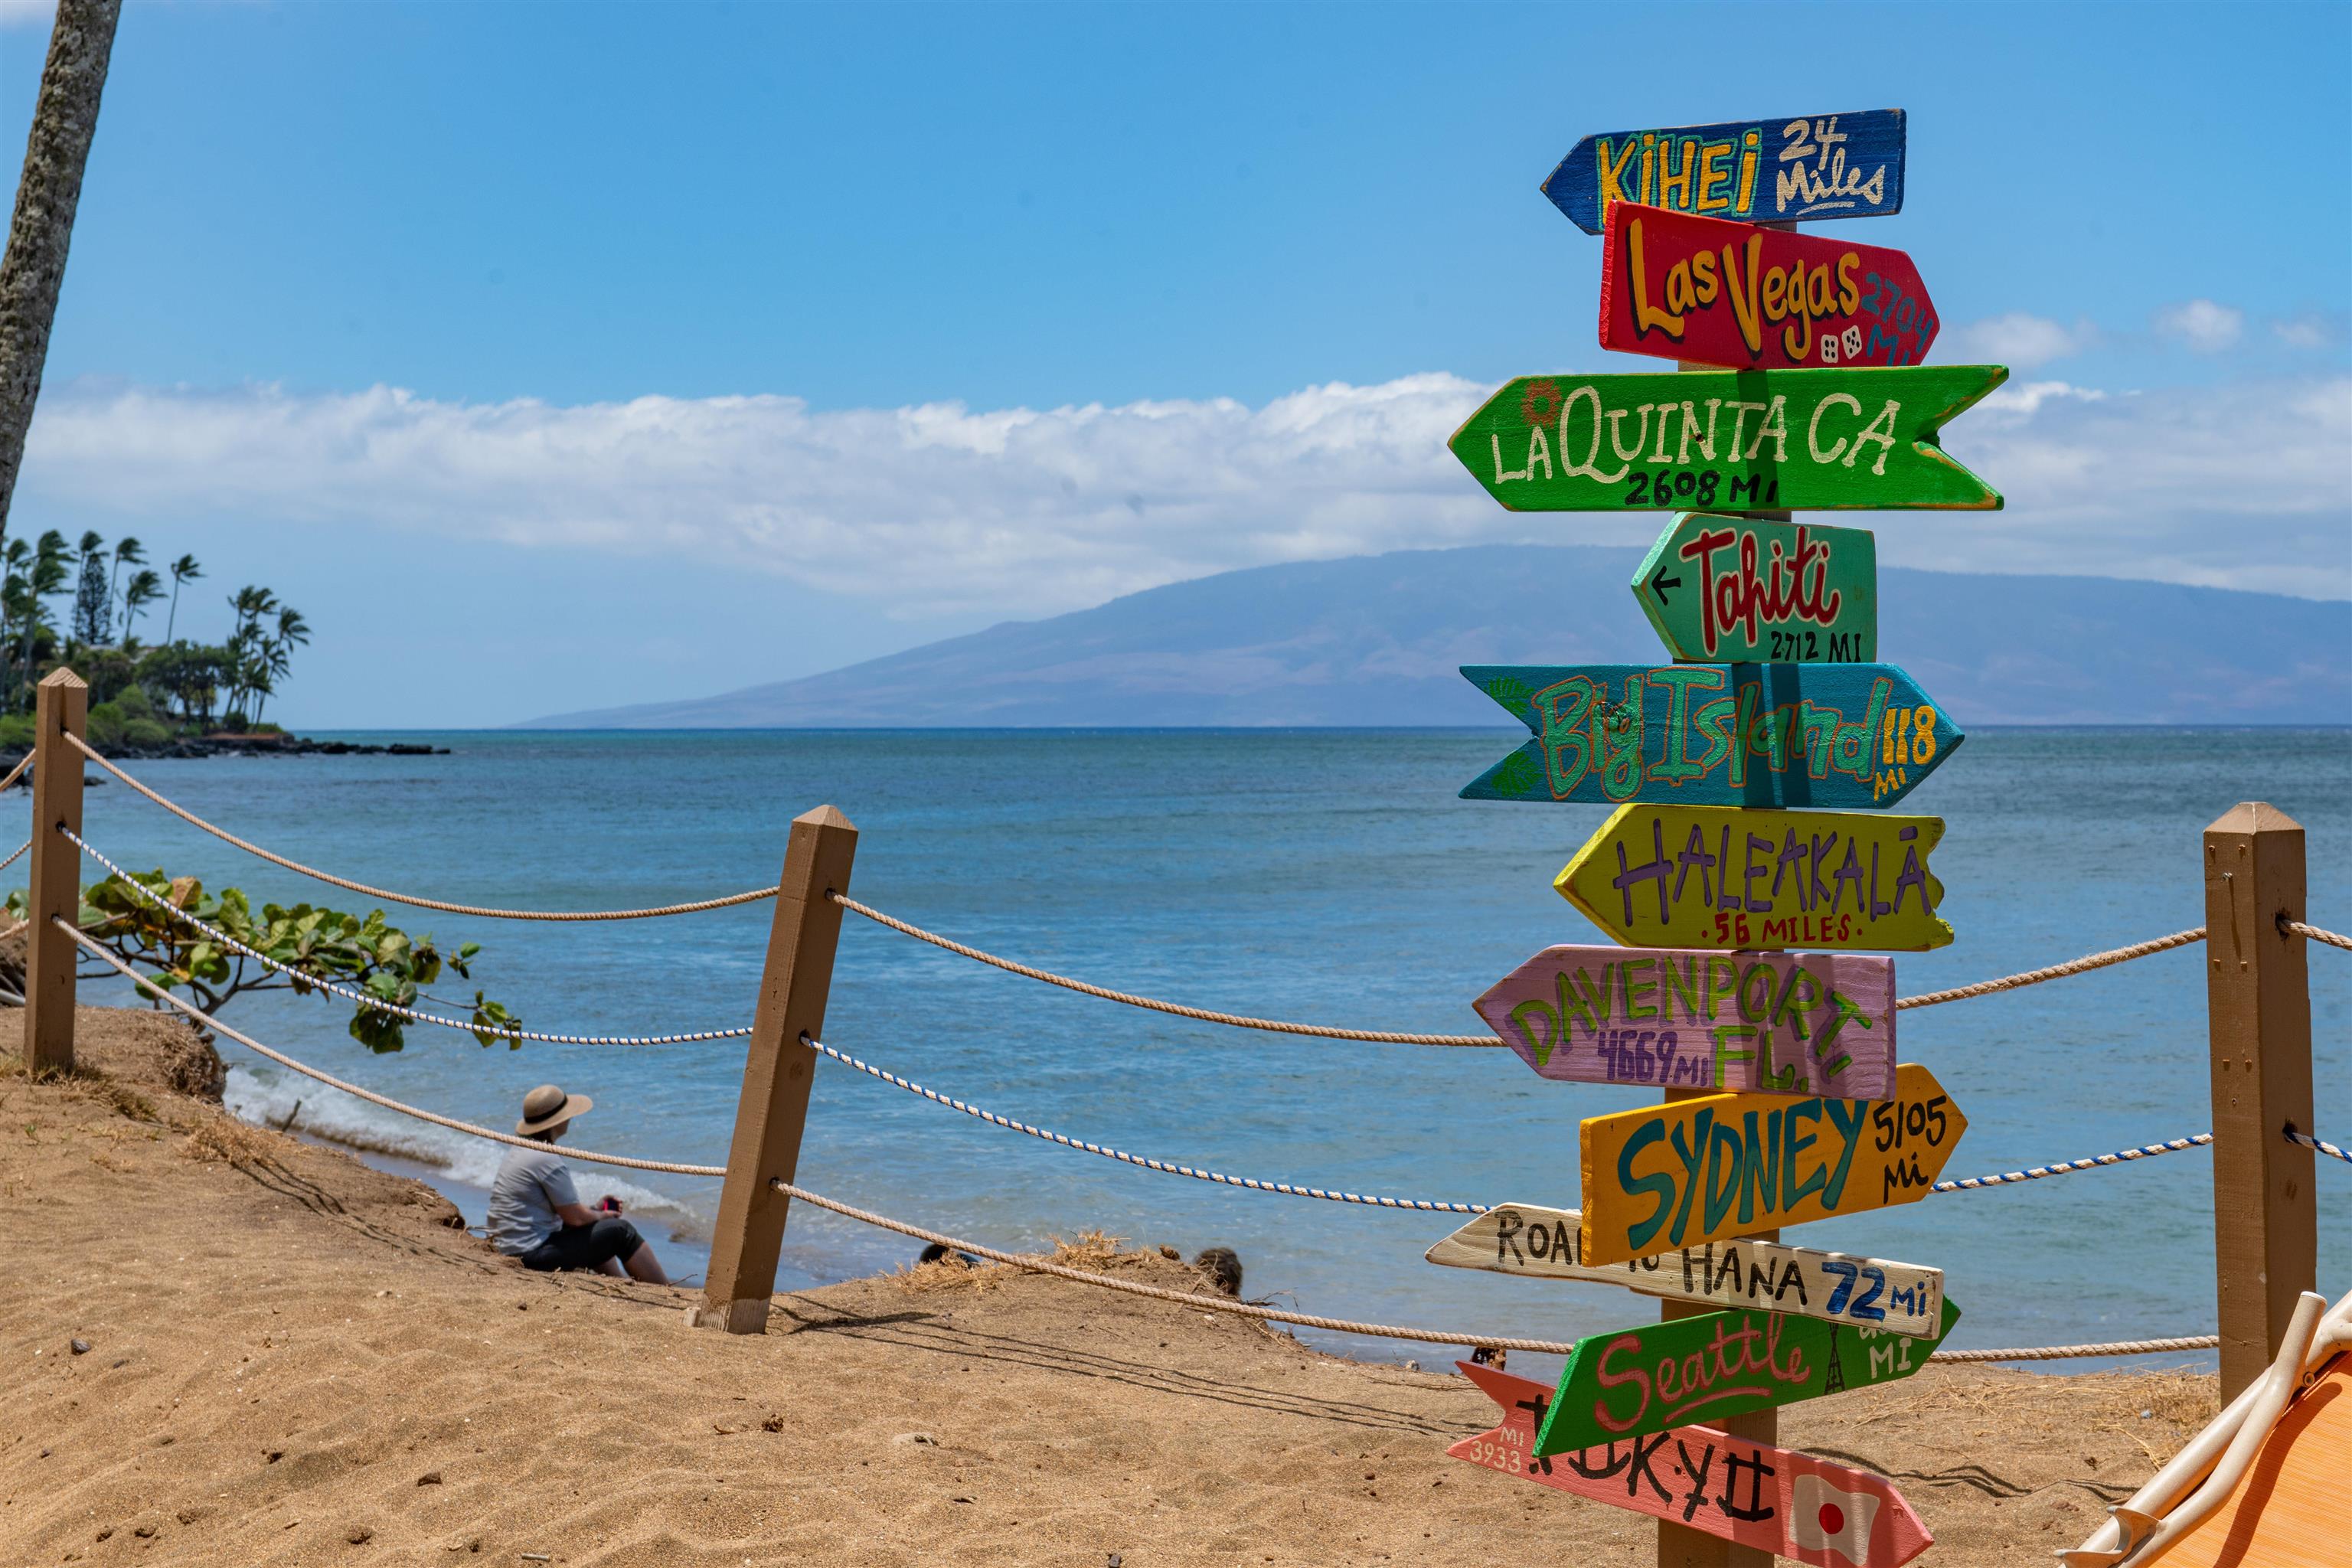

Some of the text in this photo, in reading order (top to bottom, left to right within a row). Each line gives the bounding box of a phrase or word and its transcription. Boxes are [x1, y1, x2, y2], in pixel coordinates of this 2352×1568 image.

[1779, 116, 1847, 170] 24
[1776, 147, 1885, 213] Miles
[1626, 217, 1860, 364] Las Vegas
[1861, 272, 1933, 353] 2704
[1491, 385, 1903, 484] LA QUINTA CA
[1624, 469, 1778, 506] 2608 MI
[1679, 525, 1841, 658] Tahiti
[1770, 630, 1861, 663] 2712 MI
[1647, 666, 1894, 788] Island
[1883, 705, 1936, 765] 118
[1873, 1095, 1947, 1152] 5105
[1617, 1099, 1870, 1251] SYDNEY
[1682, 1240, 1810, 1305] HANA
[1821, 1262, 1886, 1322] 72
[1594, 1312, 1811, 1433] Seattle
[1869, 1337, 1913, 1380] MI
[1469, 1440, 1523, 1474] 3933
[1500, 1426, 1524, 1447] MI
